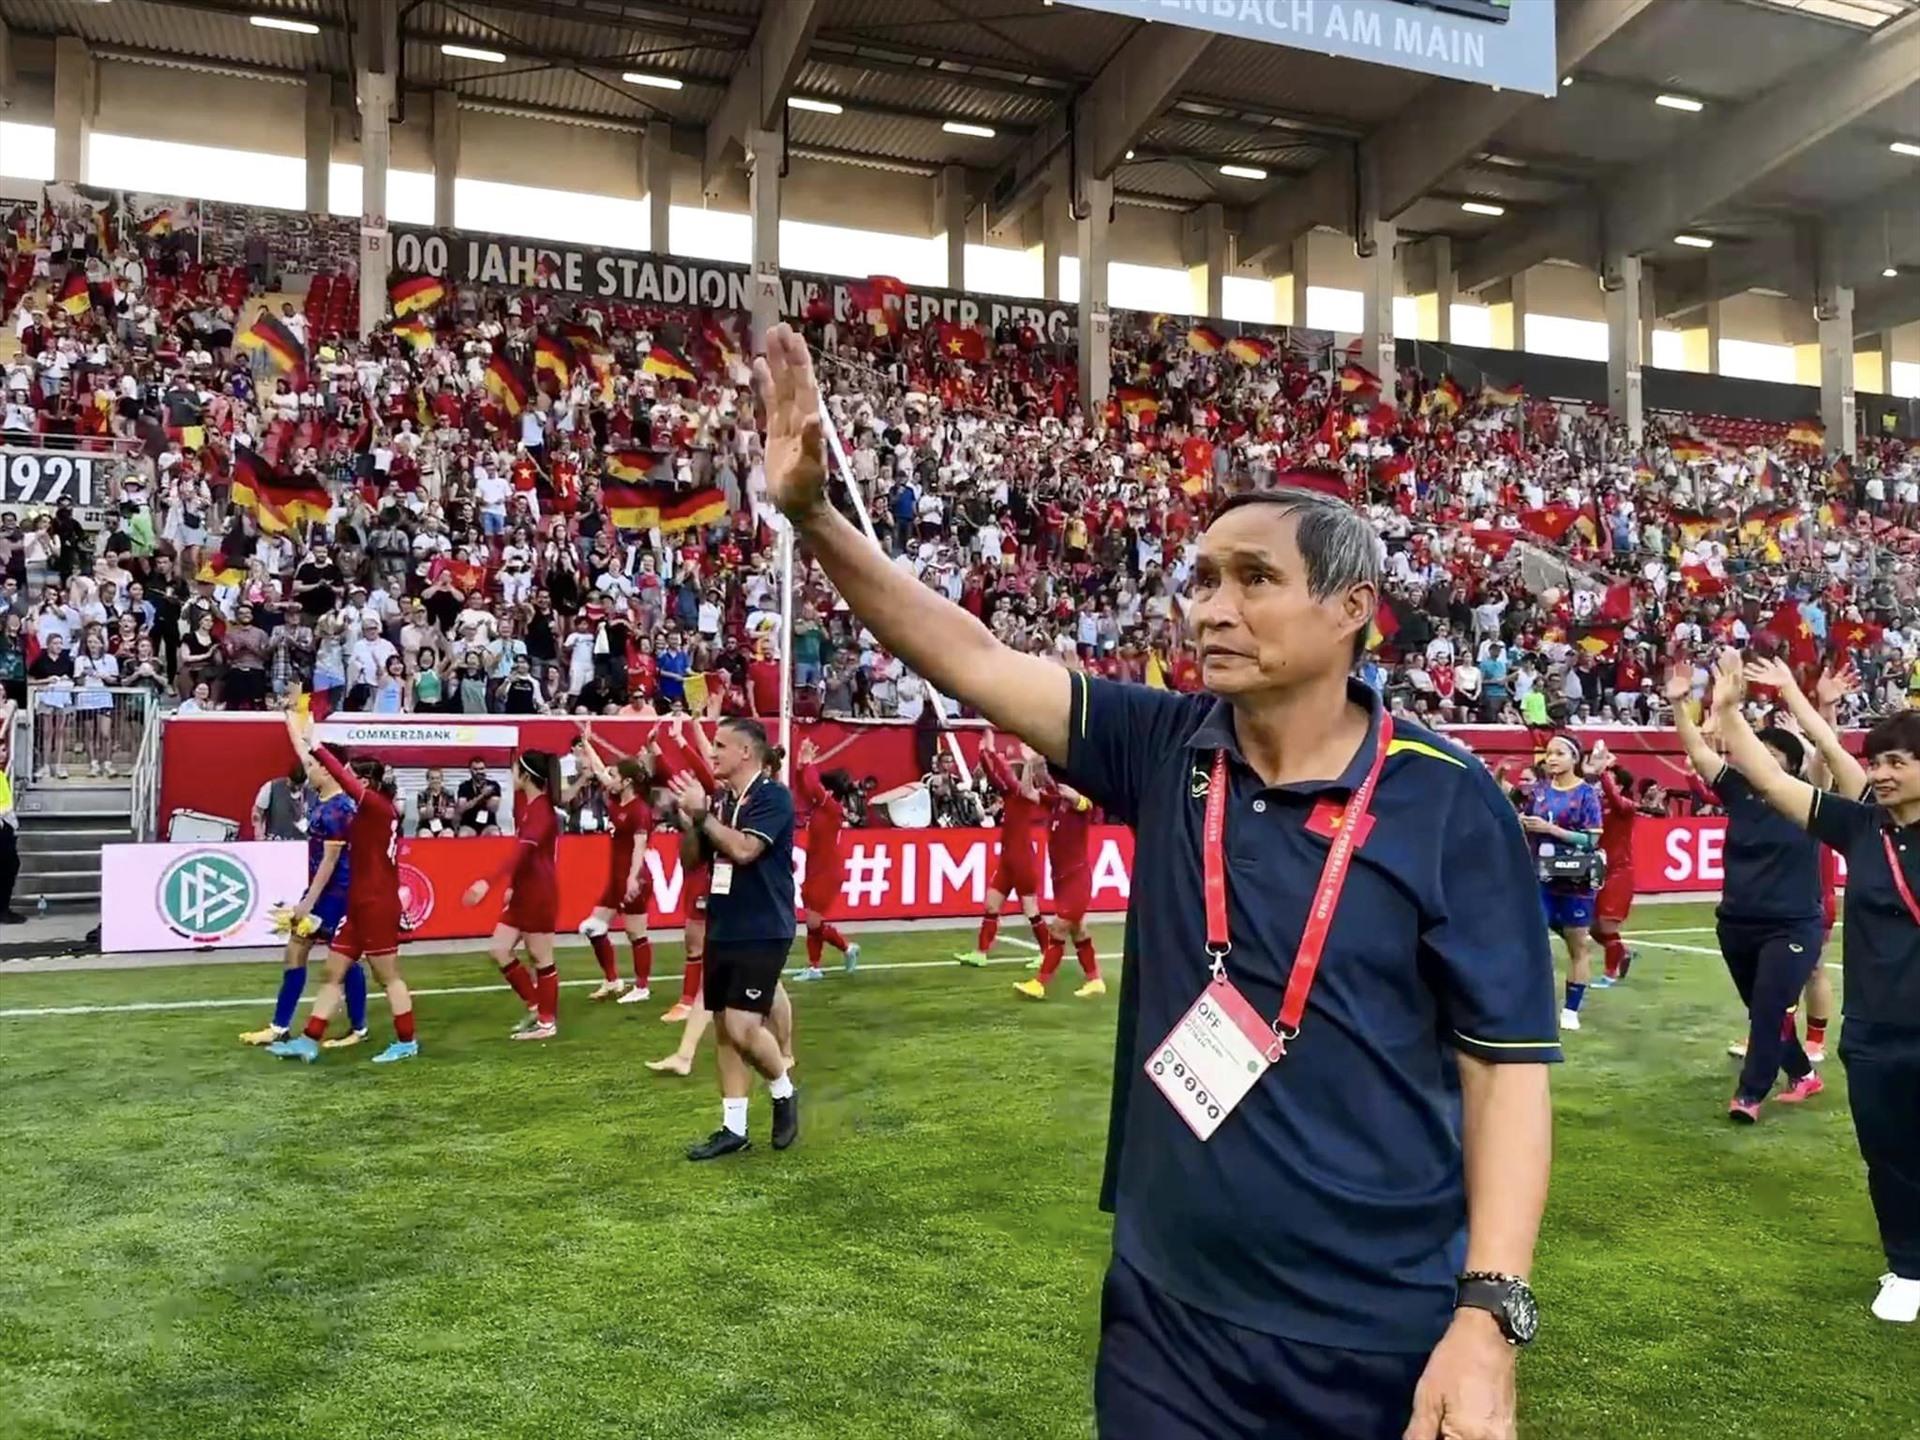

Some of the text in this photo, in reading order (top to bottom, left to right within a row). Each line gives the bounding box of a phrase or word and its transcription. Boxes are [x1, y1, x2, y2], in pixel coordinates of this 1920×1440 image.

[1160, 0, 1485, 68] BACH AM MAIN
[467, 241, 583, 292] JAHRE
[596, 256, 752, 310] STADION
[346, 729, 451, 741] COMMERZBANK
[180, 862, 245, 929] DFB
[841, 839, 1131, 907] #IMA
